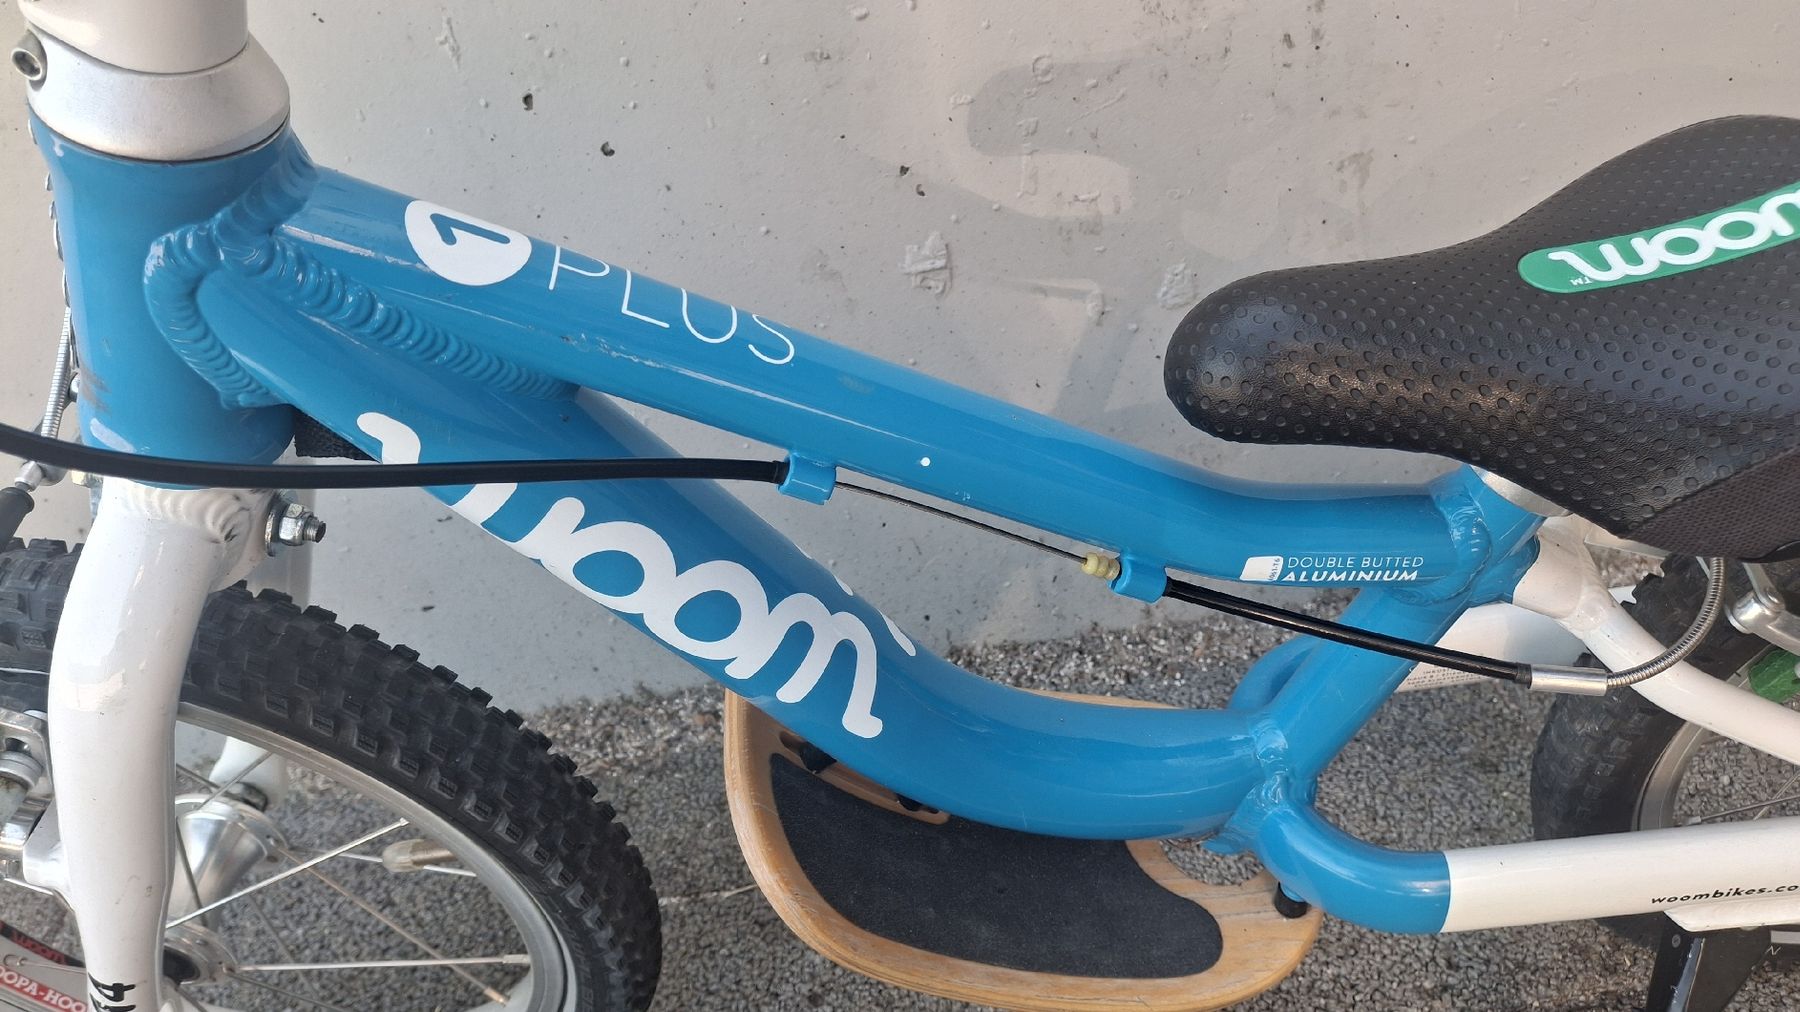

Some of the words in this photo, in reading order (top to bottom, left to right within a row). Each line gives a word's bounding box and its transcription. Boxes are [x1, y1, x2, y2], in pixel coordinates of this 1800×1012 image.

[410, 213, 511, 245] 1
[548, 245, 795, 364] PLUS
[356, 411, 883, 738] woom
[1287, 556, 1355, 568] DOUBLE
[1361, 556, 1424, 568] BUTTED
[1282, 570, 1418, 582] ALUMINIUM
[1651, 885, 1800, 904] woombikes.co
